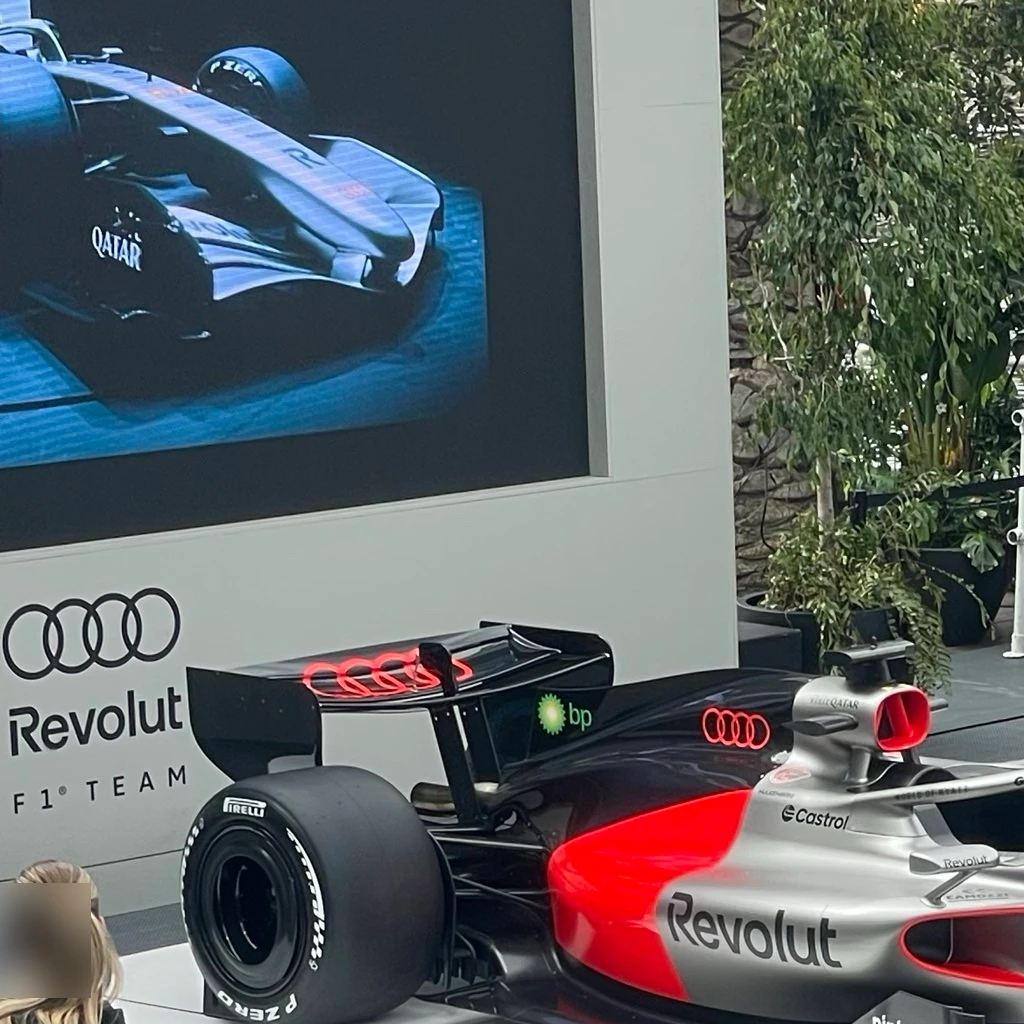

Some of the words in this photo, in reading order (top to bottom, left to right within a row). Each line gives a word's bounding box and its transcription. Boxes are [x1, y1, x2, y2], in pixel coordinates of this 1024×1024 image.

[91, 225, 143, 272] QATAR
[568, 701, 594, 732] bp
[830, 699, 859, 710] QATAR
[8, 686, 184, 757] Revolut
[86, 764, 187, 802] TEAM
[222, 797, 267, 818] PIRELLI
[795, 808, 850, 830] Castrol
[943, 855, 989, 870] Revolut
[666, 891, 843, 969] Revolut
[217, 990, 281, 1022] ZERO
[284, 993, 298, 1015] P
